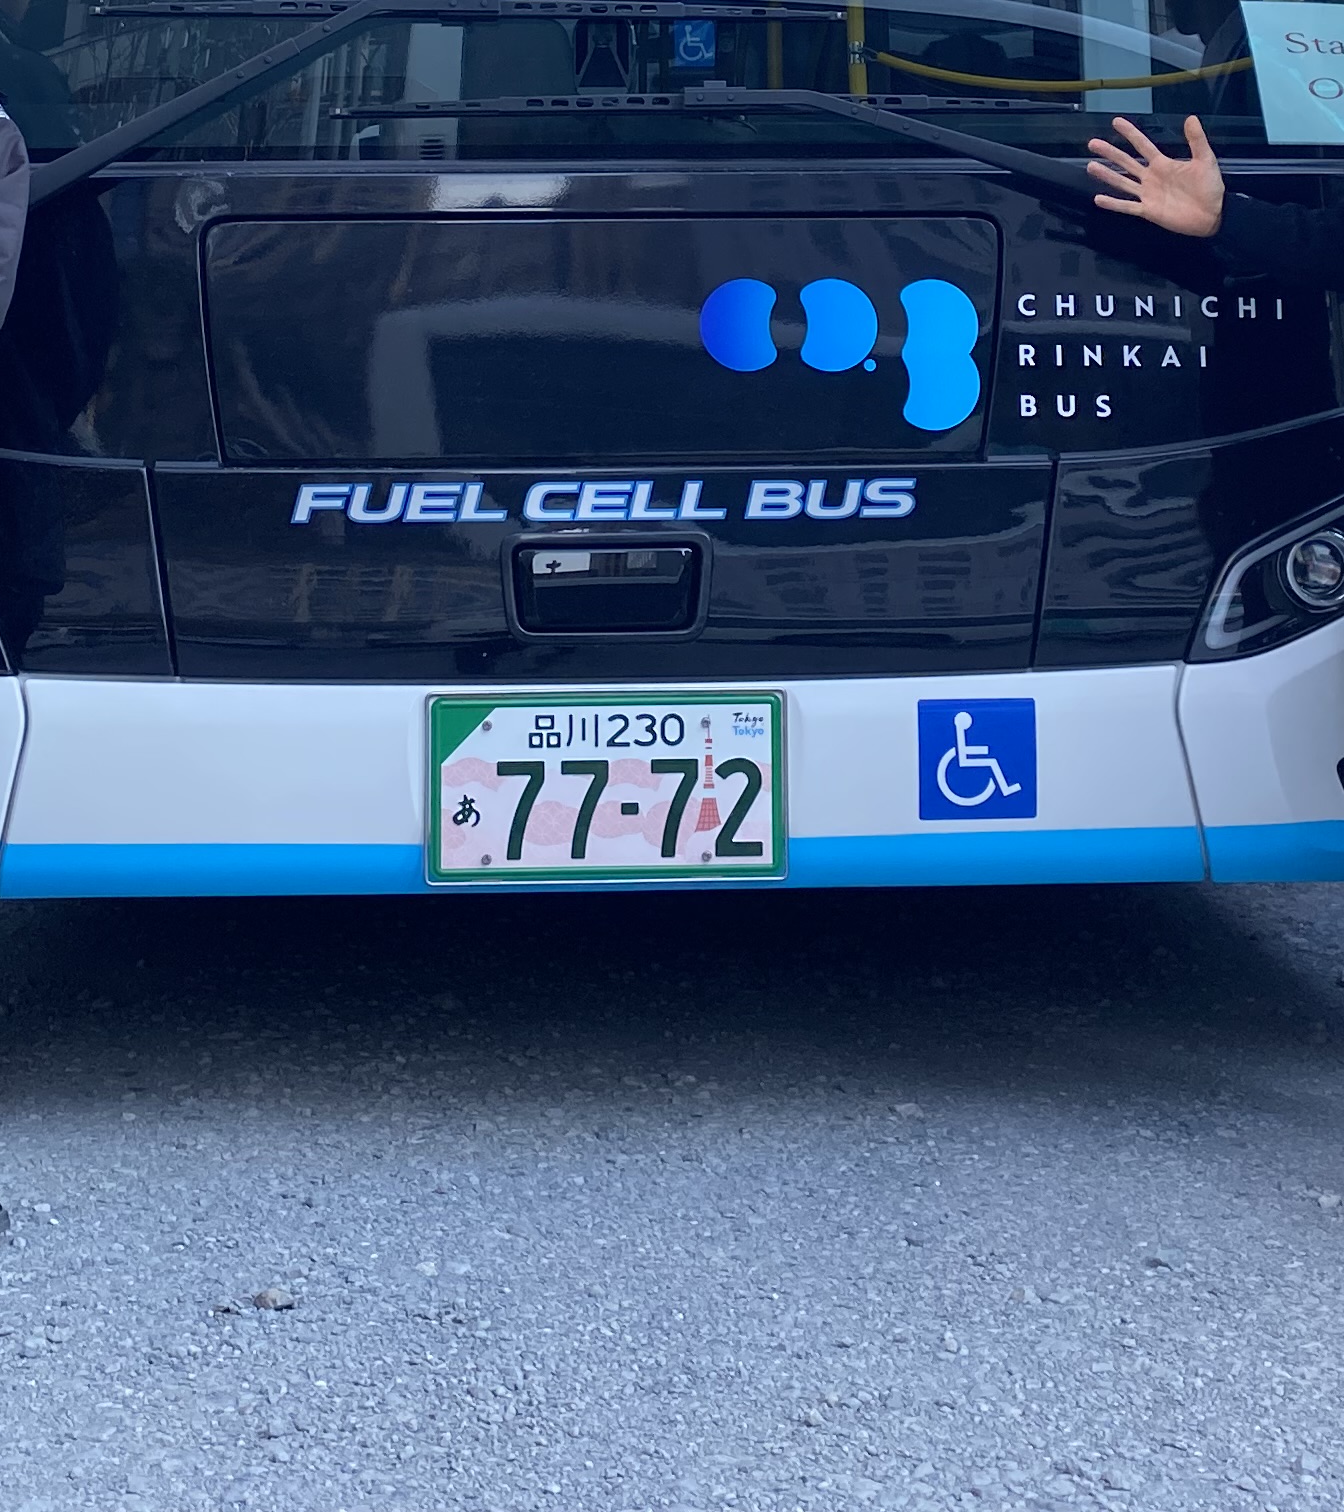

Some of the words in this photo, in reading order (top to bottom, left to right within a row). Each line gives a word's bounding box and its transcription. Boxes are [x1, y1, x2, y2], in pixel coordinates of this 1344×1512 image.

[1017, 293, 1283, 320] CHUNICHI
[1018, 343, 1207, 368] RINKAI
[1019, 393, 1112, 417] BUS
[291, 482, 508, 524] FUEL
[522, 480, 727, 522] CELL
[744, 477, 918, 521] BUS
[732, 724, 766, 737] Tokyo
[452, 794, 481, 828] あ
[496, 756, 764, 861] 77-72
